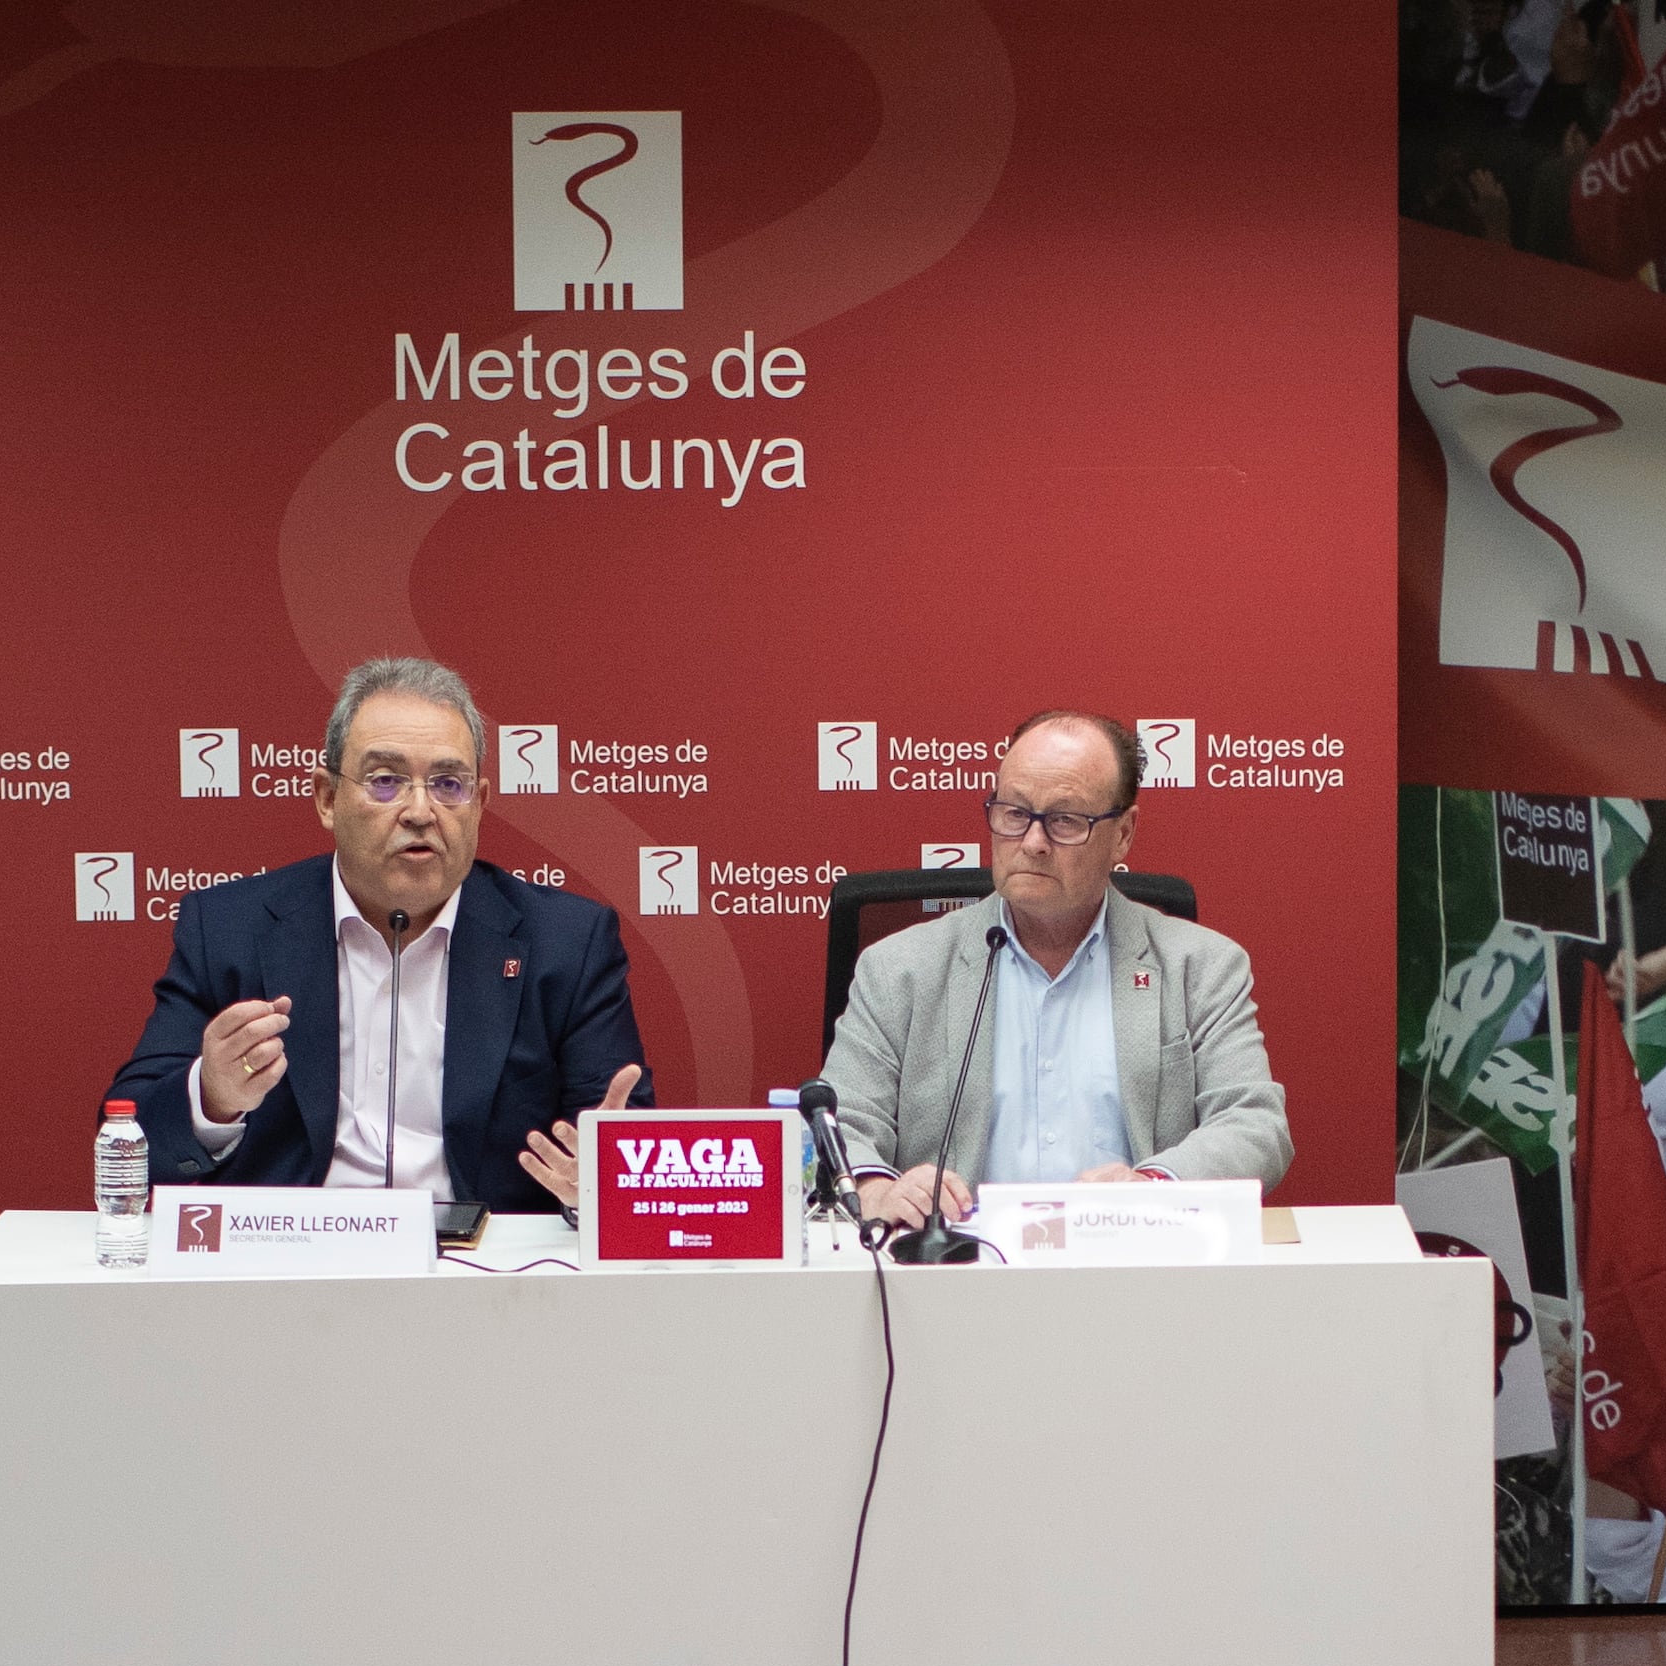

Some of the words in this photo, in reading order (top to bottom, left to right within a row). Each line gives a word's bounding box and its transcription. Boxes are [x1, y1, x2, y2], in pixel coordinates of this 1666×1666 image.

[395, 333, 689, 418] Metges
[711, 330, 806, 398] de
[395, 422, 806, 507] Catalunya
[38, 746, 70, 770] de
[570, 740, 669, 769] Metges
[675, 739, 708, 763] de
[889, 737, 988, 766] Metges
[1207, 735, 1306, 764] Metges
[1312, 734, 1344, 757] de
[570, 770, 708, 798] Catalunya
[1207, 764, 1344, 793] Catalunya
[1565, 801, 1586, 833] de
[710, 861, 810, 890] Metges
[816, 860, 847, 883] de
[617, 1138, 763, 1173] VAGA
[617, 1174, 640, 1188] DE
[644, 1174, 763, 1188] FACULTATIUS
[633, 1202, 650, 1214] 25
[659, 1202, 676, 1214] 26
[677, 1204, 715, 1216] gener
[716, 1201, 749, 1214] 2023
[229, 1215, 295, 1232] XAVIER
[300, 1216, 399, 1233] LLEONART
[229, 1234, 273, 1243] SECRETARI
[275, 1234, 312, 1244] GENERAL
[1581, 1368, 1623, 1431] de
